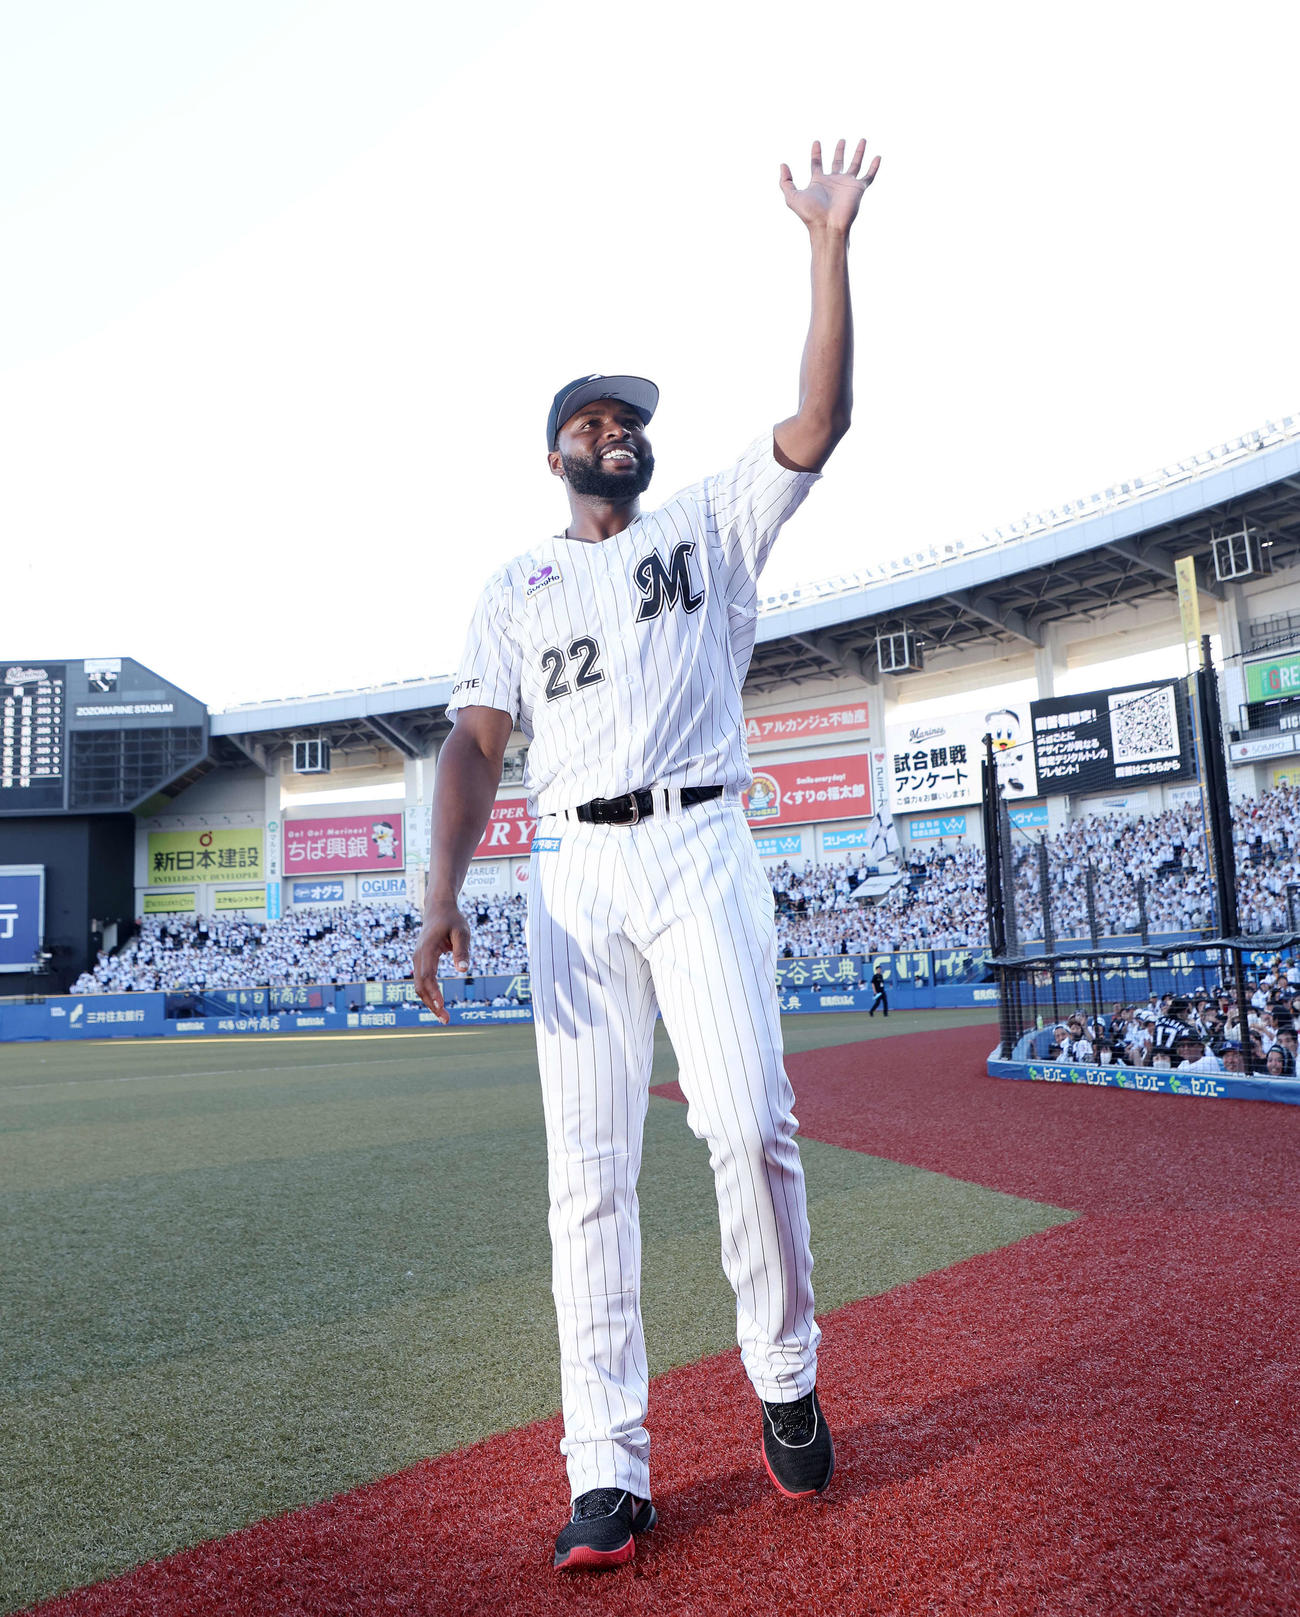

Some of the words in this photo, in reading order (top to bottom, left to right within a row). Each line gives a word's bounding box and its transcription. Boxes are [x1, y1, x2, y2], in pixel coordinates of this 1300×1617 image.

[526, 574, 561, 596] GungHo
[540, 634, 606, 702] 22
[452, 677, 480, 695] OTTE
[134, 704, 173, 714] STADIUM
[762, 709, 866, 735] アルカンジュ不動産
[894, 744, 968, 774] 試合観戦
[895, 768, 968, 793] アンケート
[782, 783, 865, 805] くすりの福太郎
[490, 807, 524, 820] UPER
[327, 827, 367, 836] Marines!
[481, 820, 537, 847] RY
[153, 847, 259, 872] 新日本建設
[288, 836, 369, 862] ちば興銀
[311, 885, 343, 900] オグラ
[362, 879, 407, 893] OGURA
[386, 982, 443, 1002] 新昭
[361, 1013, 396, 1026] 新昭和
[1156, 1026, 1177, 1048] 17
